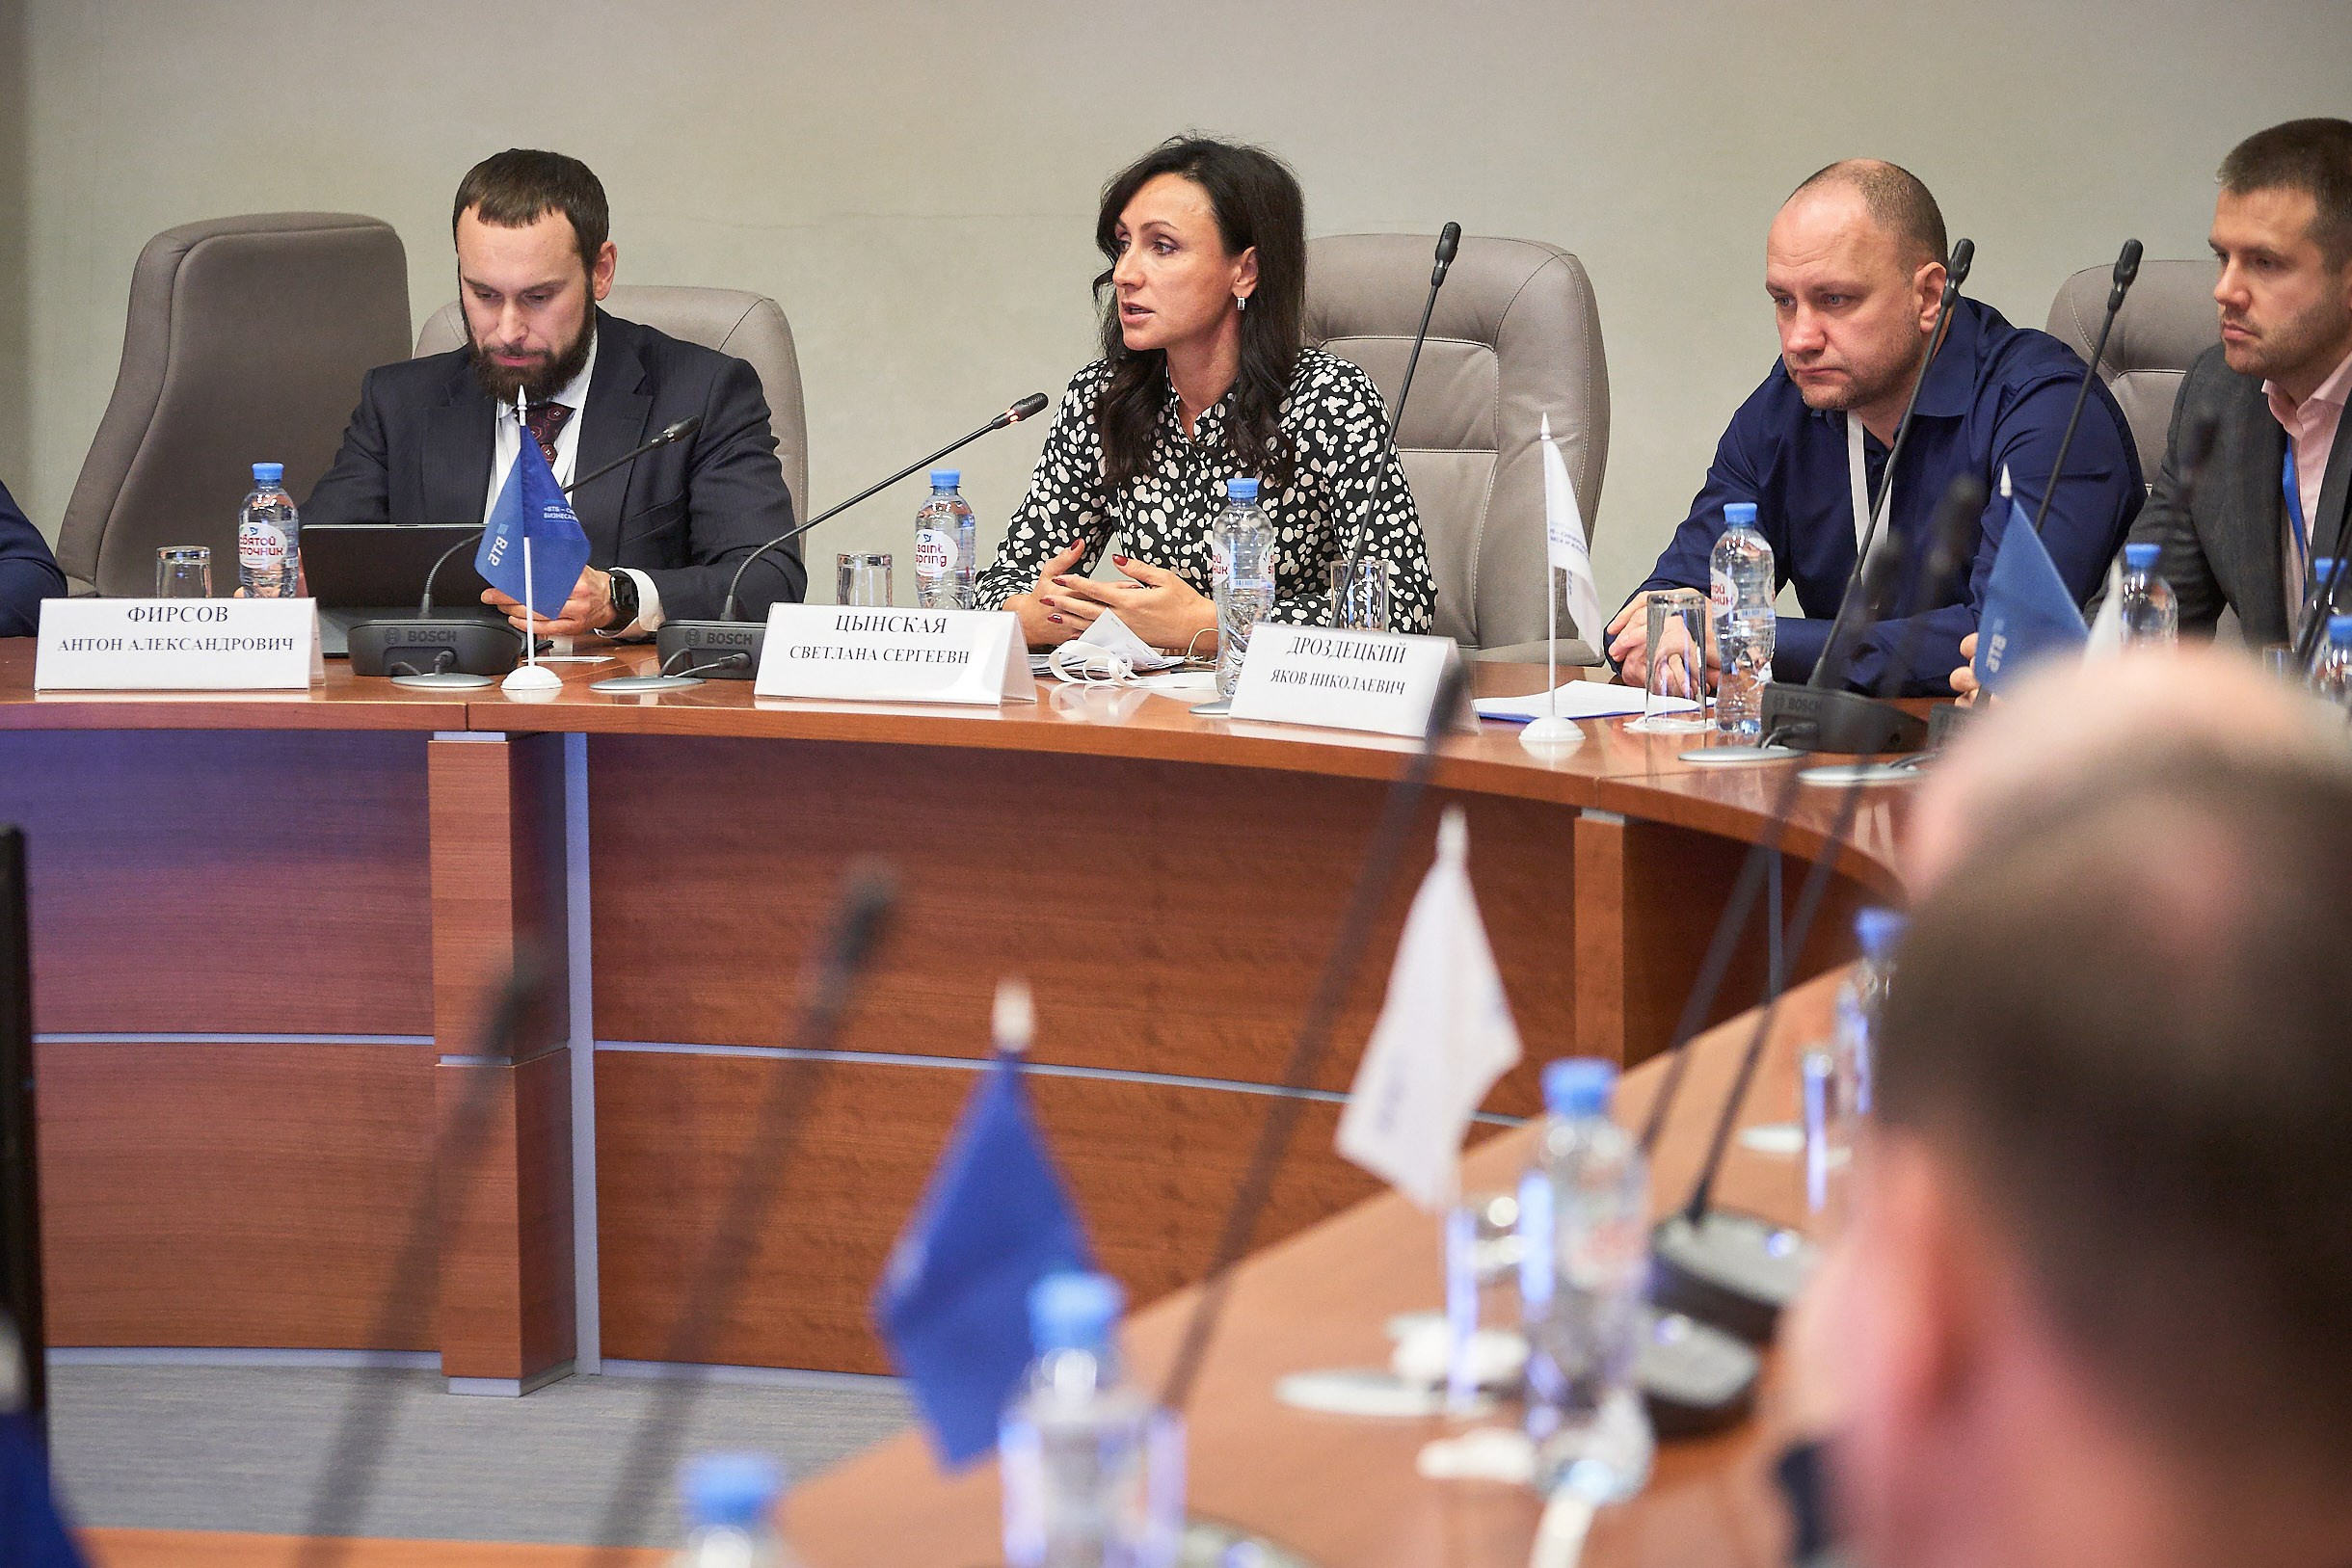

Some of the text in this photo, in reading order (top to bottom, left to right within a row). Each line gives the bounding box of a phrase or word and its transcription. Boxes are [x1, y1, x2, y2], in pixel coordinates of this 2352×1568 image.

[239, 546, 283, 556] сточник
[127, 606, 228, 623] ФИРСОВ
[835, 615, 948, 634] ЦЫНСКАЯ
[57, 637, 294, 651] АНТОН АЛЕКСАНДРОВИЧ
[408, 630, 457, 642] BOSCH
[707, 632, 753, 645] BOSCH
[789, 645, 970, 664] СВЕТЛАНА СЕРГЕЕВН
[1286, 636, 1407, 664] ДРОЗДЕЦКИЙ
[1270, 669, 1406, 695] ЯКОВ НИКОЛАЕВИЧ
